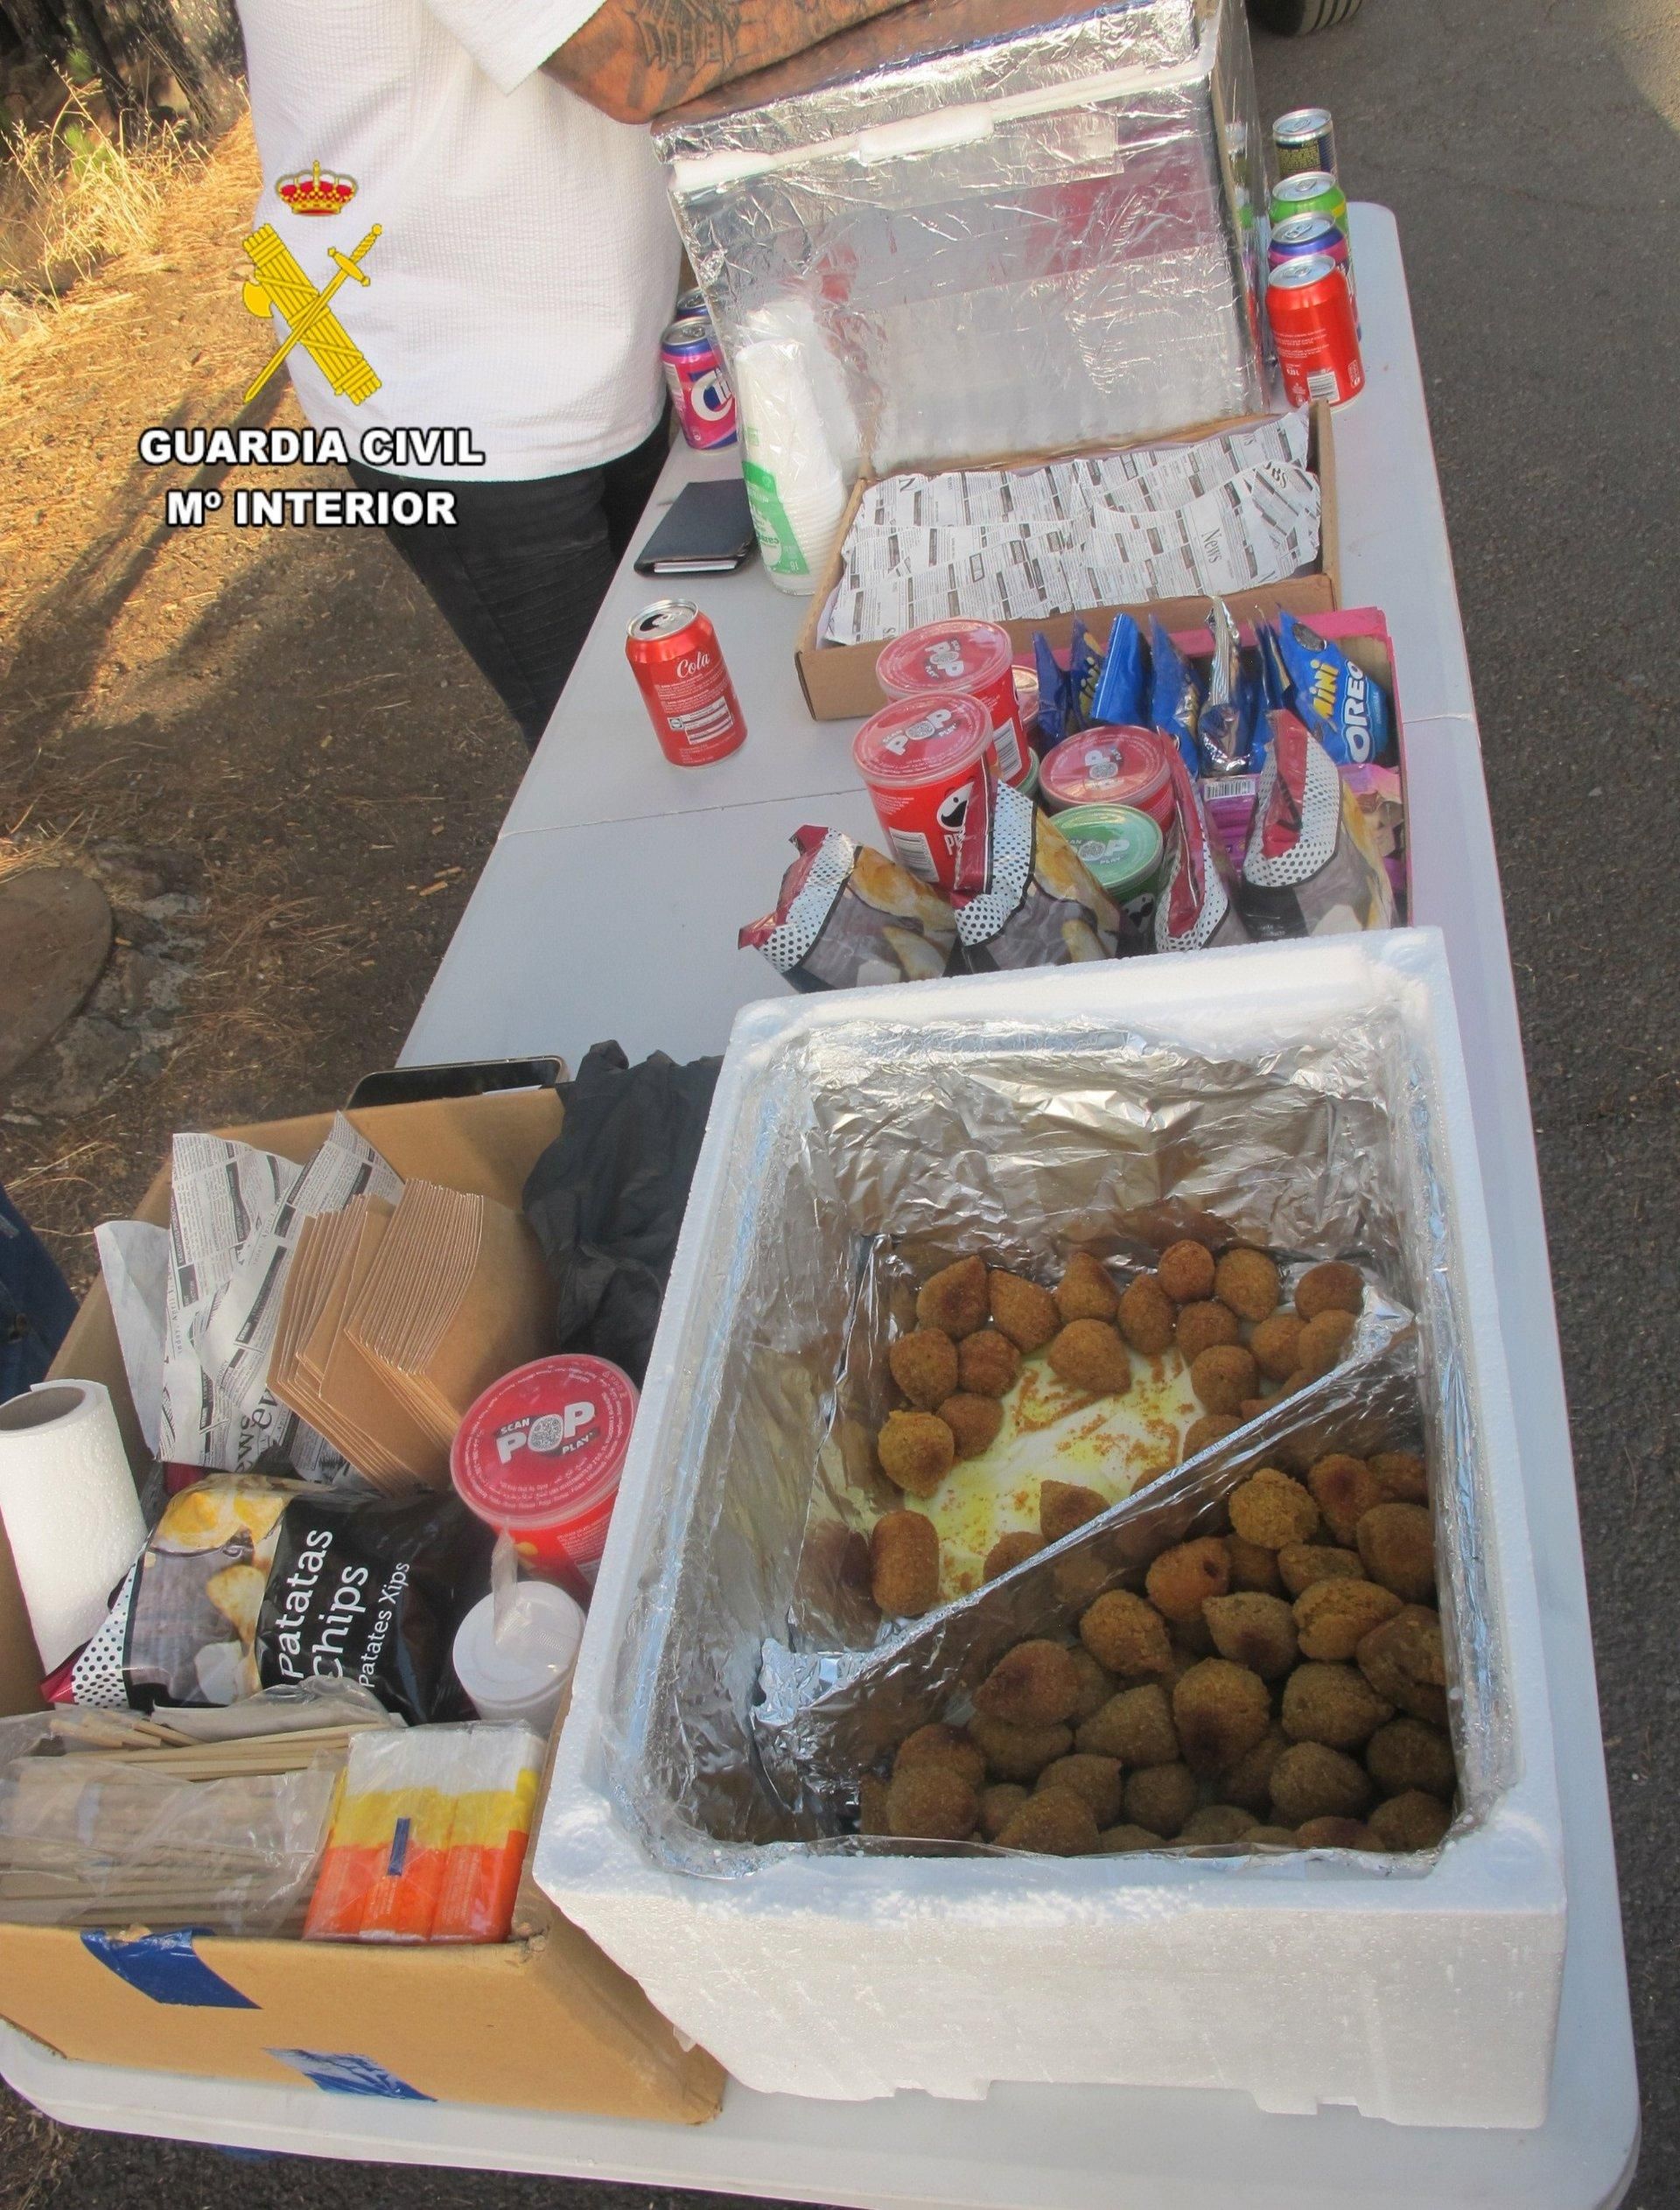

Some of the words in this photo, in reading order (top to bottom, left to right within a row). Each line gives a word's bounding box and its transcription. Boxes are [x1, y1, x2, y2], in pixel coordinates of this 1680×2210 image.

[1201, 528, 1222, 564] News
[676, 651, 710, 679] Cola
[1345, 661, 1371, 763] OREO
[496, 1402, 596, 1465] POP
[500, 1417, 530, 1434] SCAN
[275, 1529, 332, 1679] Patatas
[312, 1566, 368, 1679] Chips
[359, 1610, 392, 1688] Patates
[378, 1562, 410, 1605] Xips
